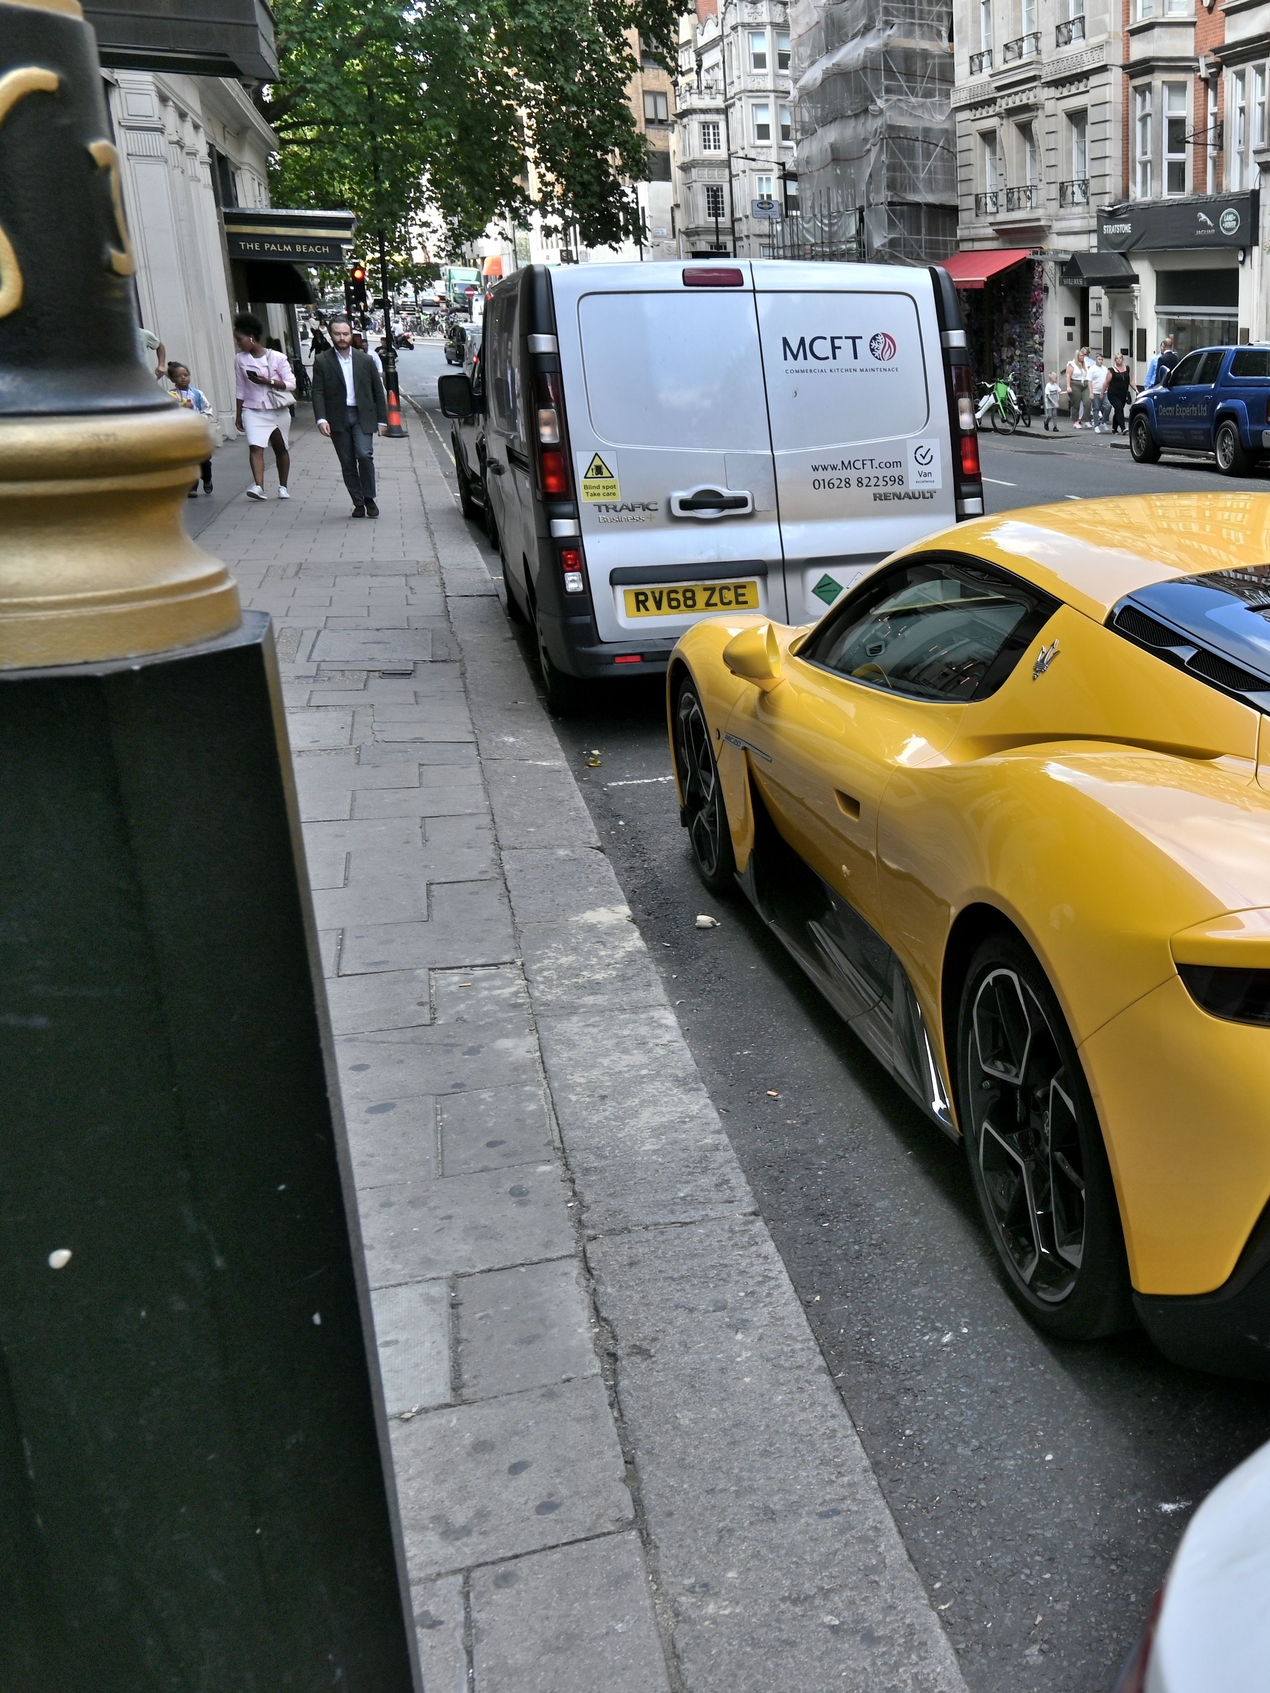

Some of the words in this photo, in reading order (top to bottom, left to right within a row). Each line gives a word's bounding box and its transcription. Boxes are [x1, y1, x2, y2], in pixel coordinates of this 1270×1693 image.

[1223, 214, 1235, 222] LAND
[1103, 223, 1132, 235] STRATSTONE
[1224, 221, 1237, 229] ROVER
[239, 242, 260, 251] THE
[264, 242, 292, 252] PALM
[295, 244, 330, 253] BEACH
[781, 335, 863, 361] MCFT
[1158, 404, 1175, 416] Decor
[1175, 404, 1198, 418] Experts
[1197, 404, 1208, 416] Ltd
[810, 459, 902, 472] www.MCFT.com
[917, 470, 933, 478] Van
[601, 484, 617, 492] spot
[812, 477, 852, 490] 01628
[856, 474, 905, 488] 822598
[872, 490, 937, 502] RENAULT
[593, 502, 659, 513] TRAFIC
[634, 588, 697, 612] RV68
[702, 584, 749, 608] ZCE
